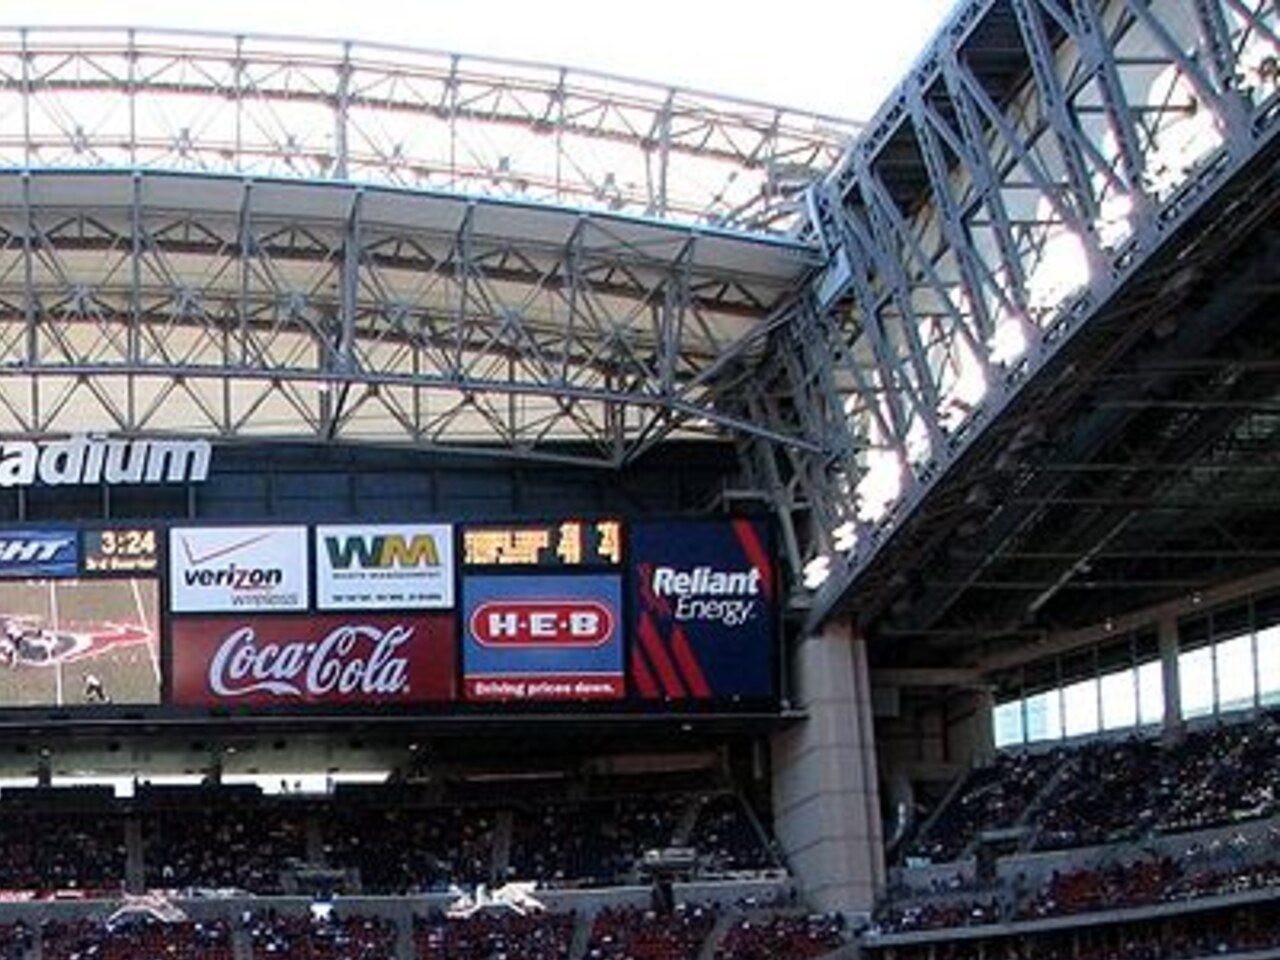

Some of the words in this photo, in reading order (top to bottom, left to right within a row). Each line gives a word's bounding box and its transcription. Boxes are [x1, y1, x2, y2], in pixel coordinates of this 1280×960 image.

[102, 530, 156, 554] 3:24
[325, 532, 440, 569] WM
[184, 563, 283, 590] verizon
[653, 566, 760, 596] Reliant
[528, 681, 570, 699] prices
